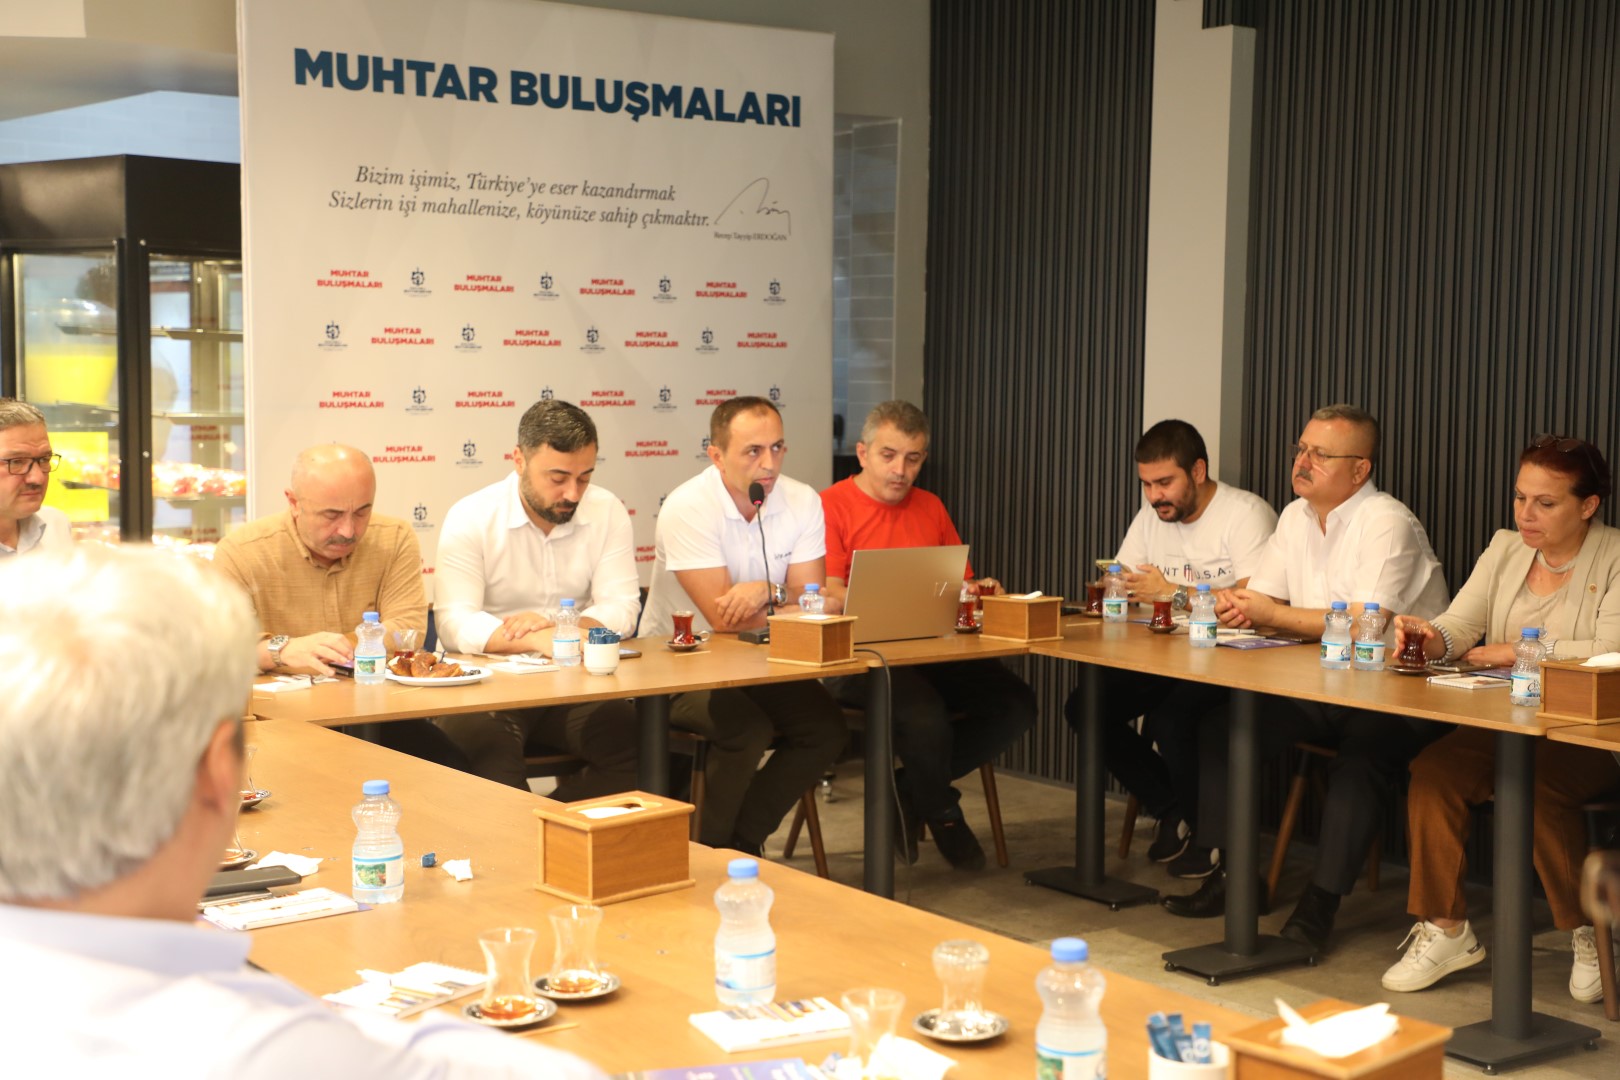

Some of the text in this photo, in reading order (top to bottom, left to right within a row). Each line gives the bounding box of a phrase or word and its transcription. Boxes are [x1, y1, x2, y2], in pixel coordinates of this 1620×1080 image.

[294, 47, 801, 128] MUHTAR BULUŞMALARI
[355, 165, 404, 186] Bizim
[409, 169, 461, 192] işimiz,
[550, 183, 578, 196] eser
[581, 180, 676, 202] kazandırmak
[329, 190, 710, 229] Sizlerin işi mahallenize, köyünüze sahip çıkmaktır.
[330, 269, 369, 278] MUHTAR
[466, 274, 502, 283] MUHTAR
[591, 278, 624, 287] MUHTAR
[316, 279, 383, 289] BULUŞMALARI
[453, 283, 515, 293] BULUŞMALARI
[705, 281, 737, 289] MUHTAR
[384, 327, 422, 335] MUHTAR
[515, 329, 550, 337] MUHTAR
[635, 331, 668, 339] MUHTAR
[371, 336, 435, 345] BULUŞMALARI
[747, 332, 777, 340] MUHTAR
[503, 339, 561, 347] BULUŞMALARI
[332, 390, 371, 398] MUHTAR
[466, 390, 503, 398] MUHTAR
[591, 390, 624, 398] MUHTAR
[319, 400, 384, 409] BULUŞMALARI
[455, 400, 516, 409] BULUŞMALARI
[385, 445, 423, 453] MUHTAR
[635, 441, 668, 449] MUHTAR
[372, 454, 436, 463] BULUŞMALARI
